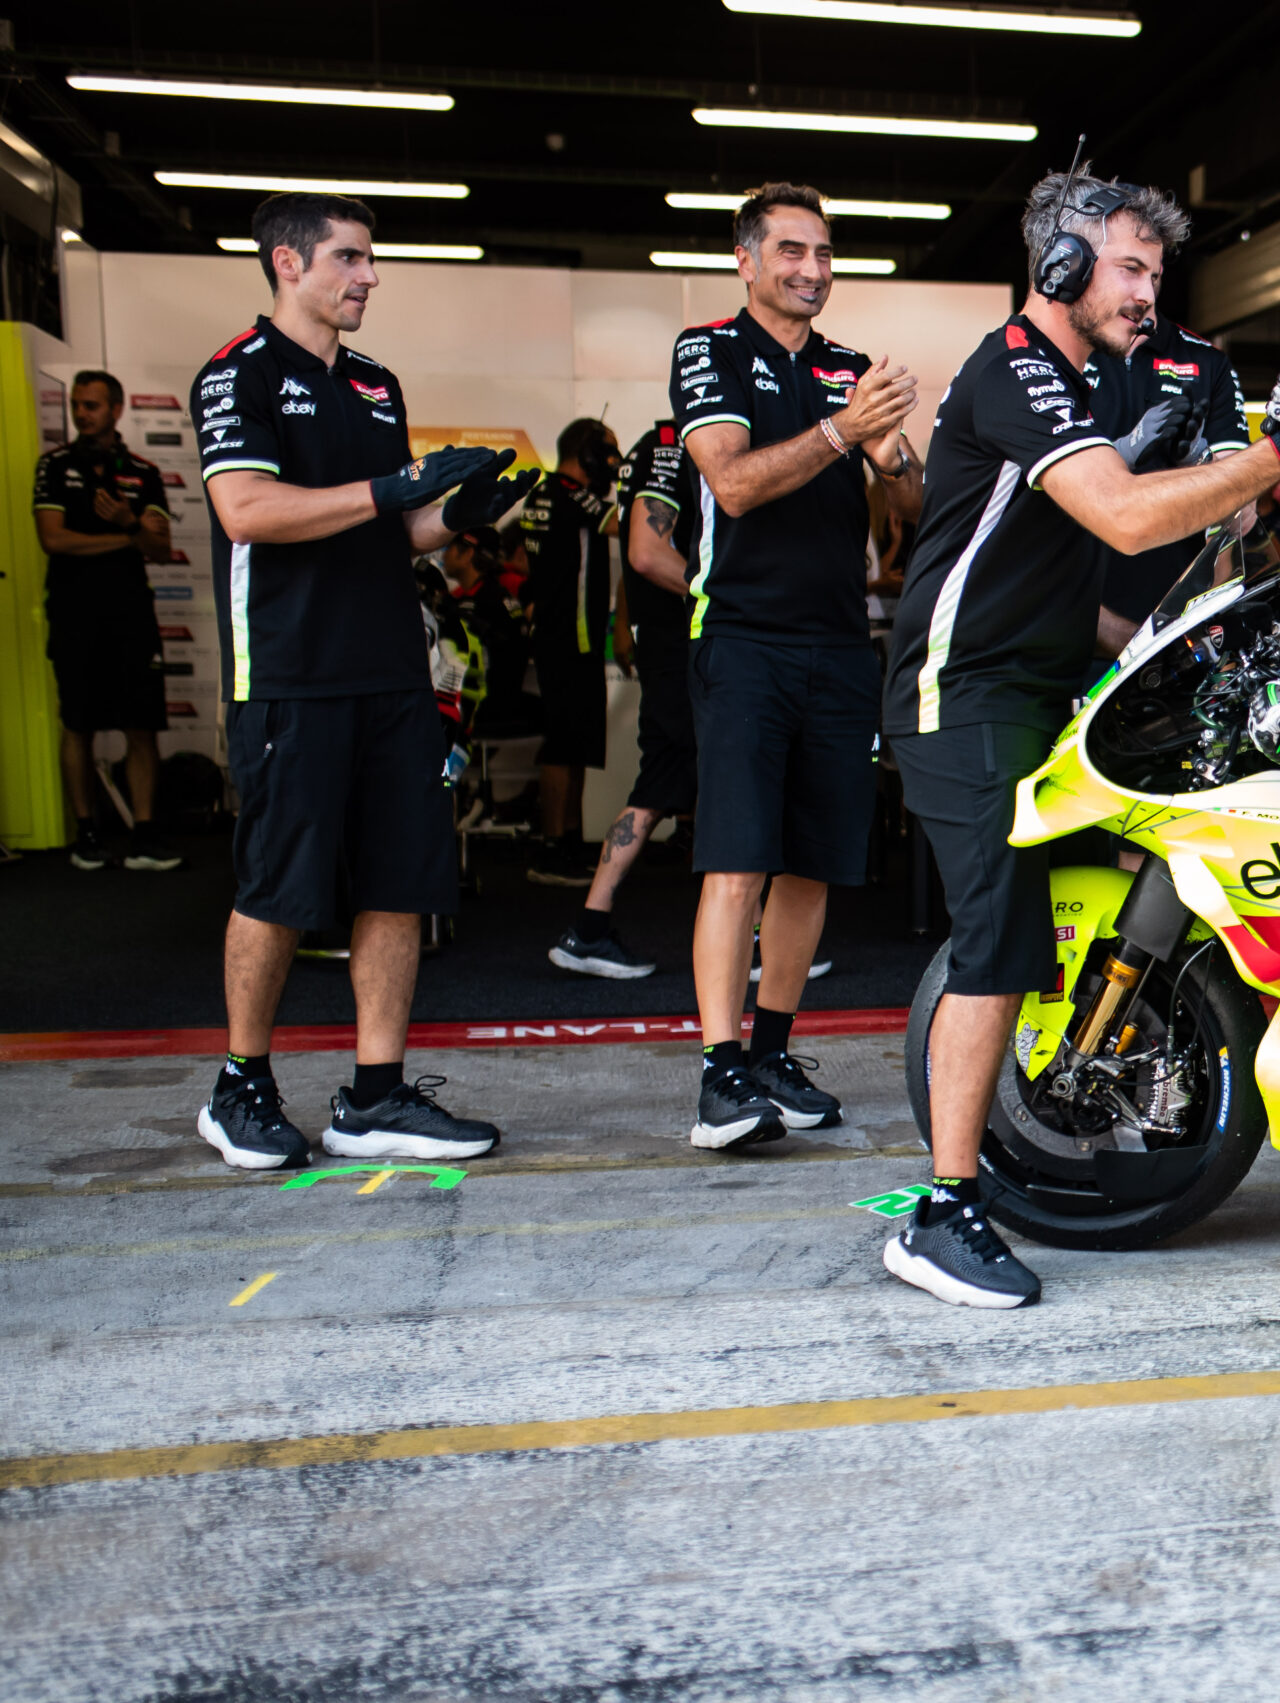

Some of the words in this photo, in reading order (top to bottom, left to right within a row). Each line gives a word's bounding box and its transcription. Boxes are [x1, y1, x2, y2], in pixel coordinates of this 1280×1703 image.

[678, 345, 710, 359] HERO
[819, 371, 856, 383] Enduro
[201, 381, 234, 397] HERO
[755, 377, 780, 394] ebay
[1161, 383, 1183, 395] DUCA
[827, 394, 849, 405] DUCA
[282, 401, 317, 416] ebay
[1055, 901, 1084, 914] RO
[467, 1020, 754, 1039] T-LANE
[1160, 1081, 1171, 1118] brembo
[1218, 1069, 1231, 1128] MICHELIN
